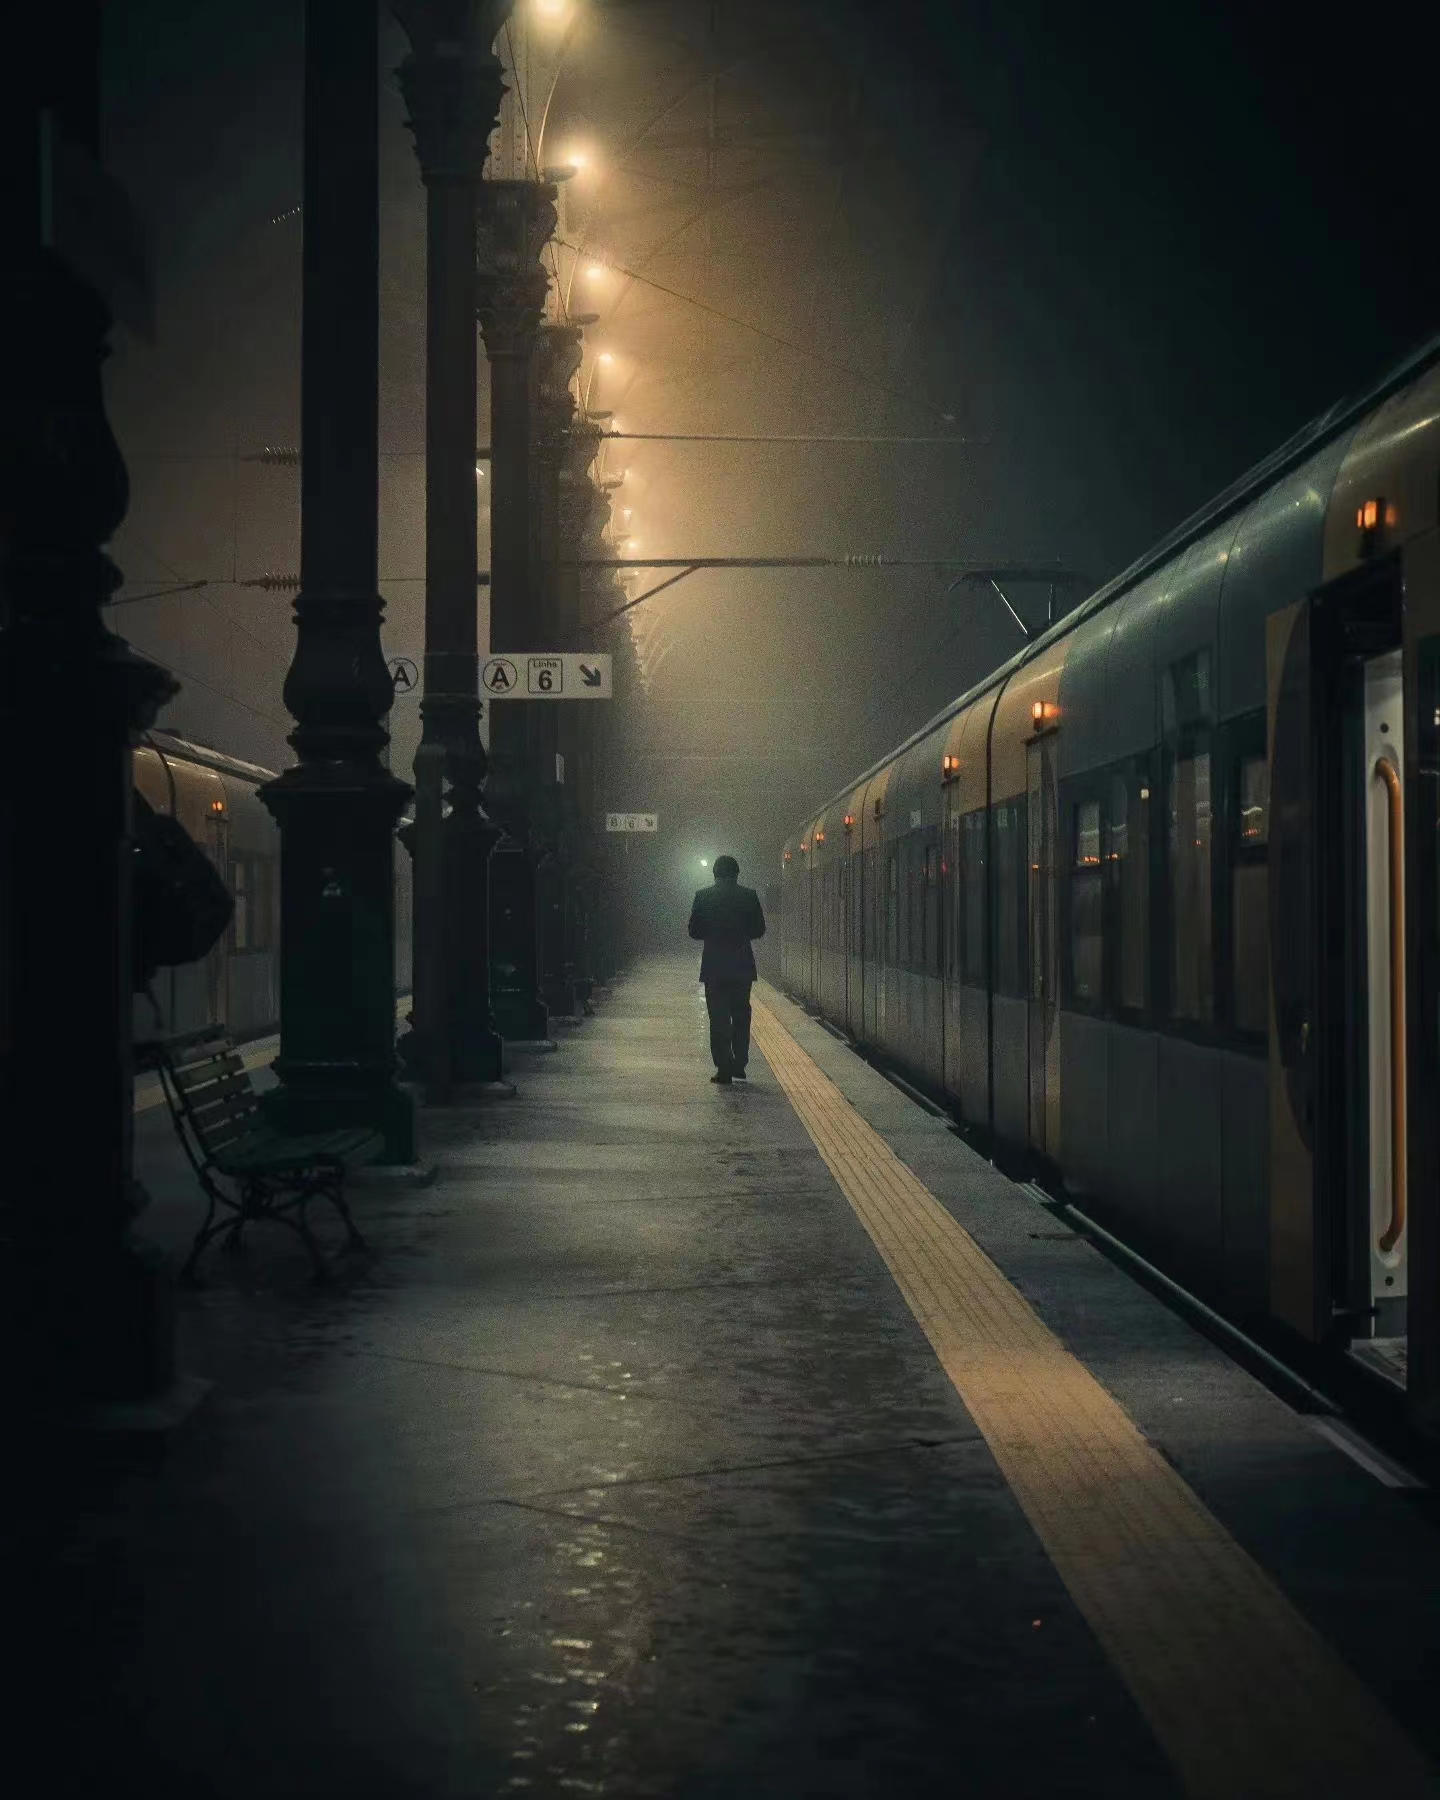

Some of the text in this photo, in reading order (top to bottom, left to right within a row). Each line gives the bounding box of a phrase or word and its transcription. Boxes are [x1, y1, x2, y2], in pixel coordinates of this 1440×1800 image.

[533, 660, 558, 668] Linha
[392, 666, 410, 687] A
[490, 666, 510, 687] A
[538, 670, 553, 690] 6
